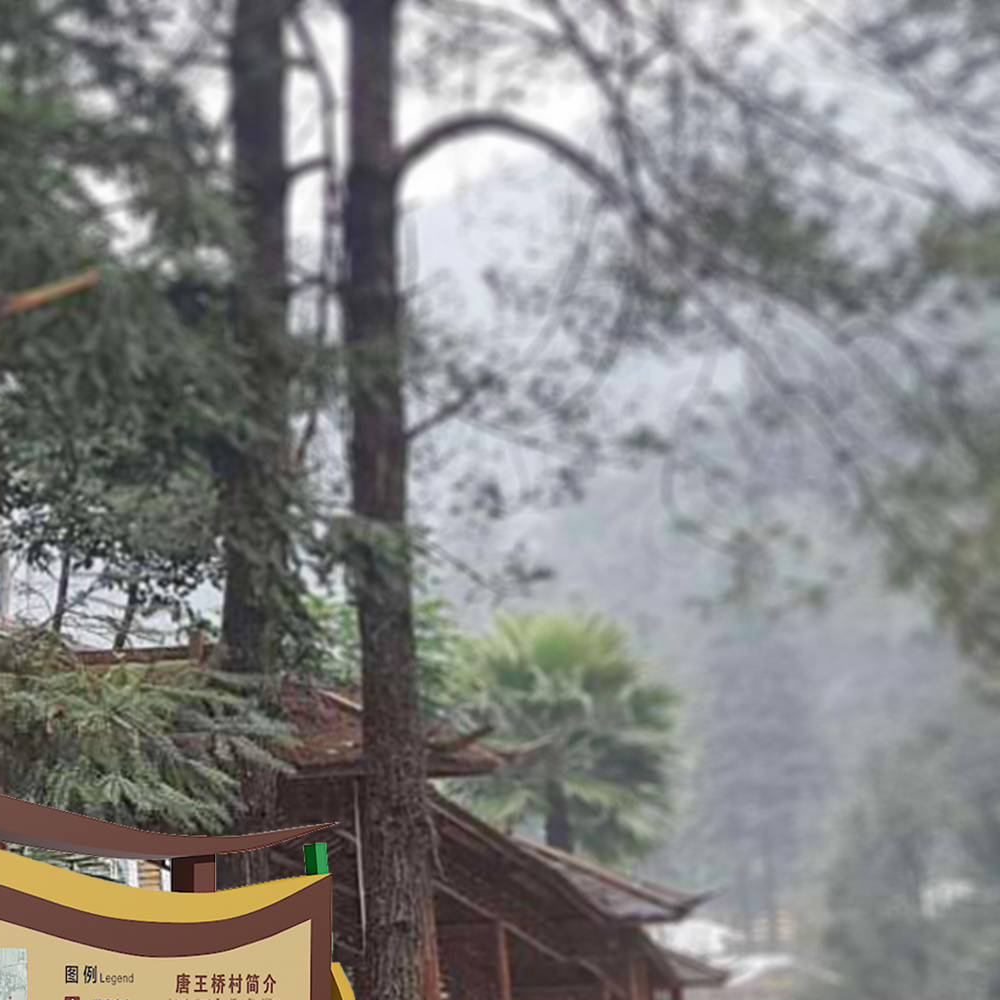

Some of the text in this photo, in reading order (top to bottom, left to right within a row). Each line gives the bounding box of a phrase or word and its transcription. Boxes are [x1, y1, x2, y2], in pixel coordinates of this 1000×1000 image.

[65, 965, 135, 986] 图例 Legend
[175, 973, 277, 994] 唐王桥村简介
